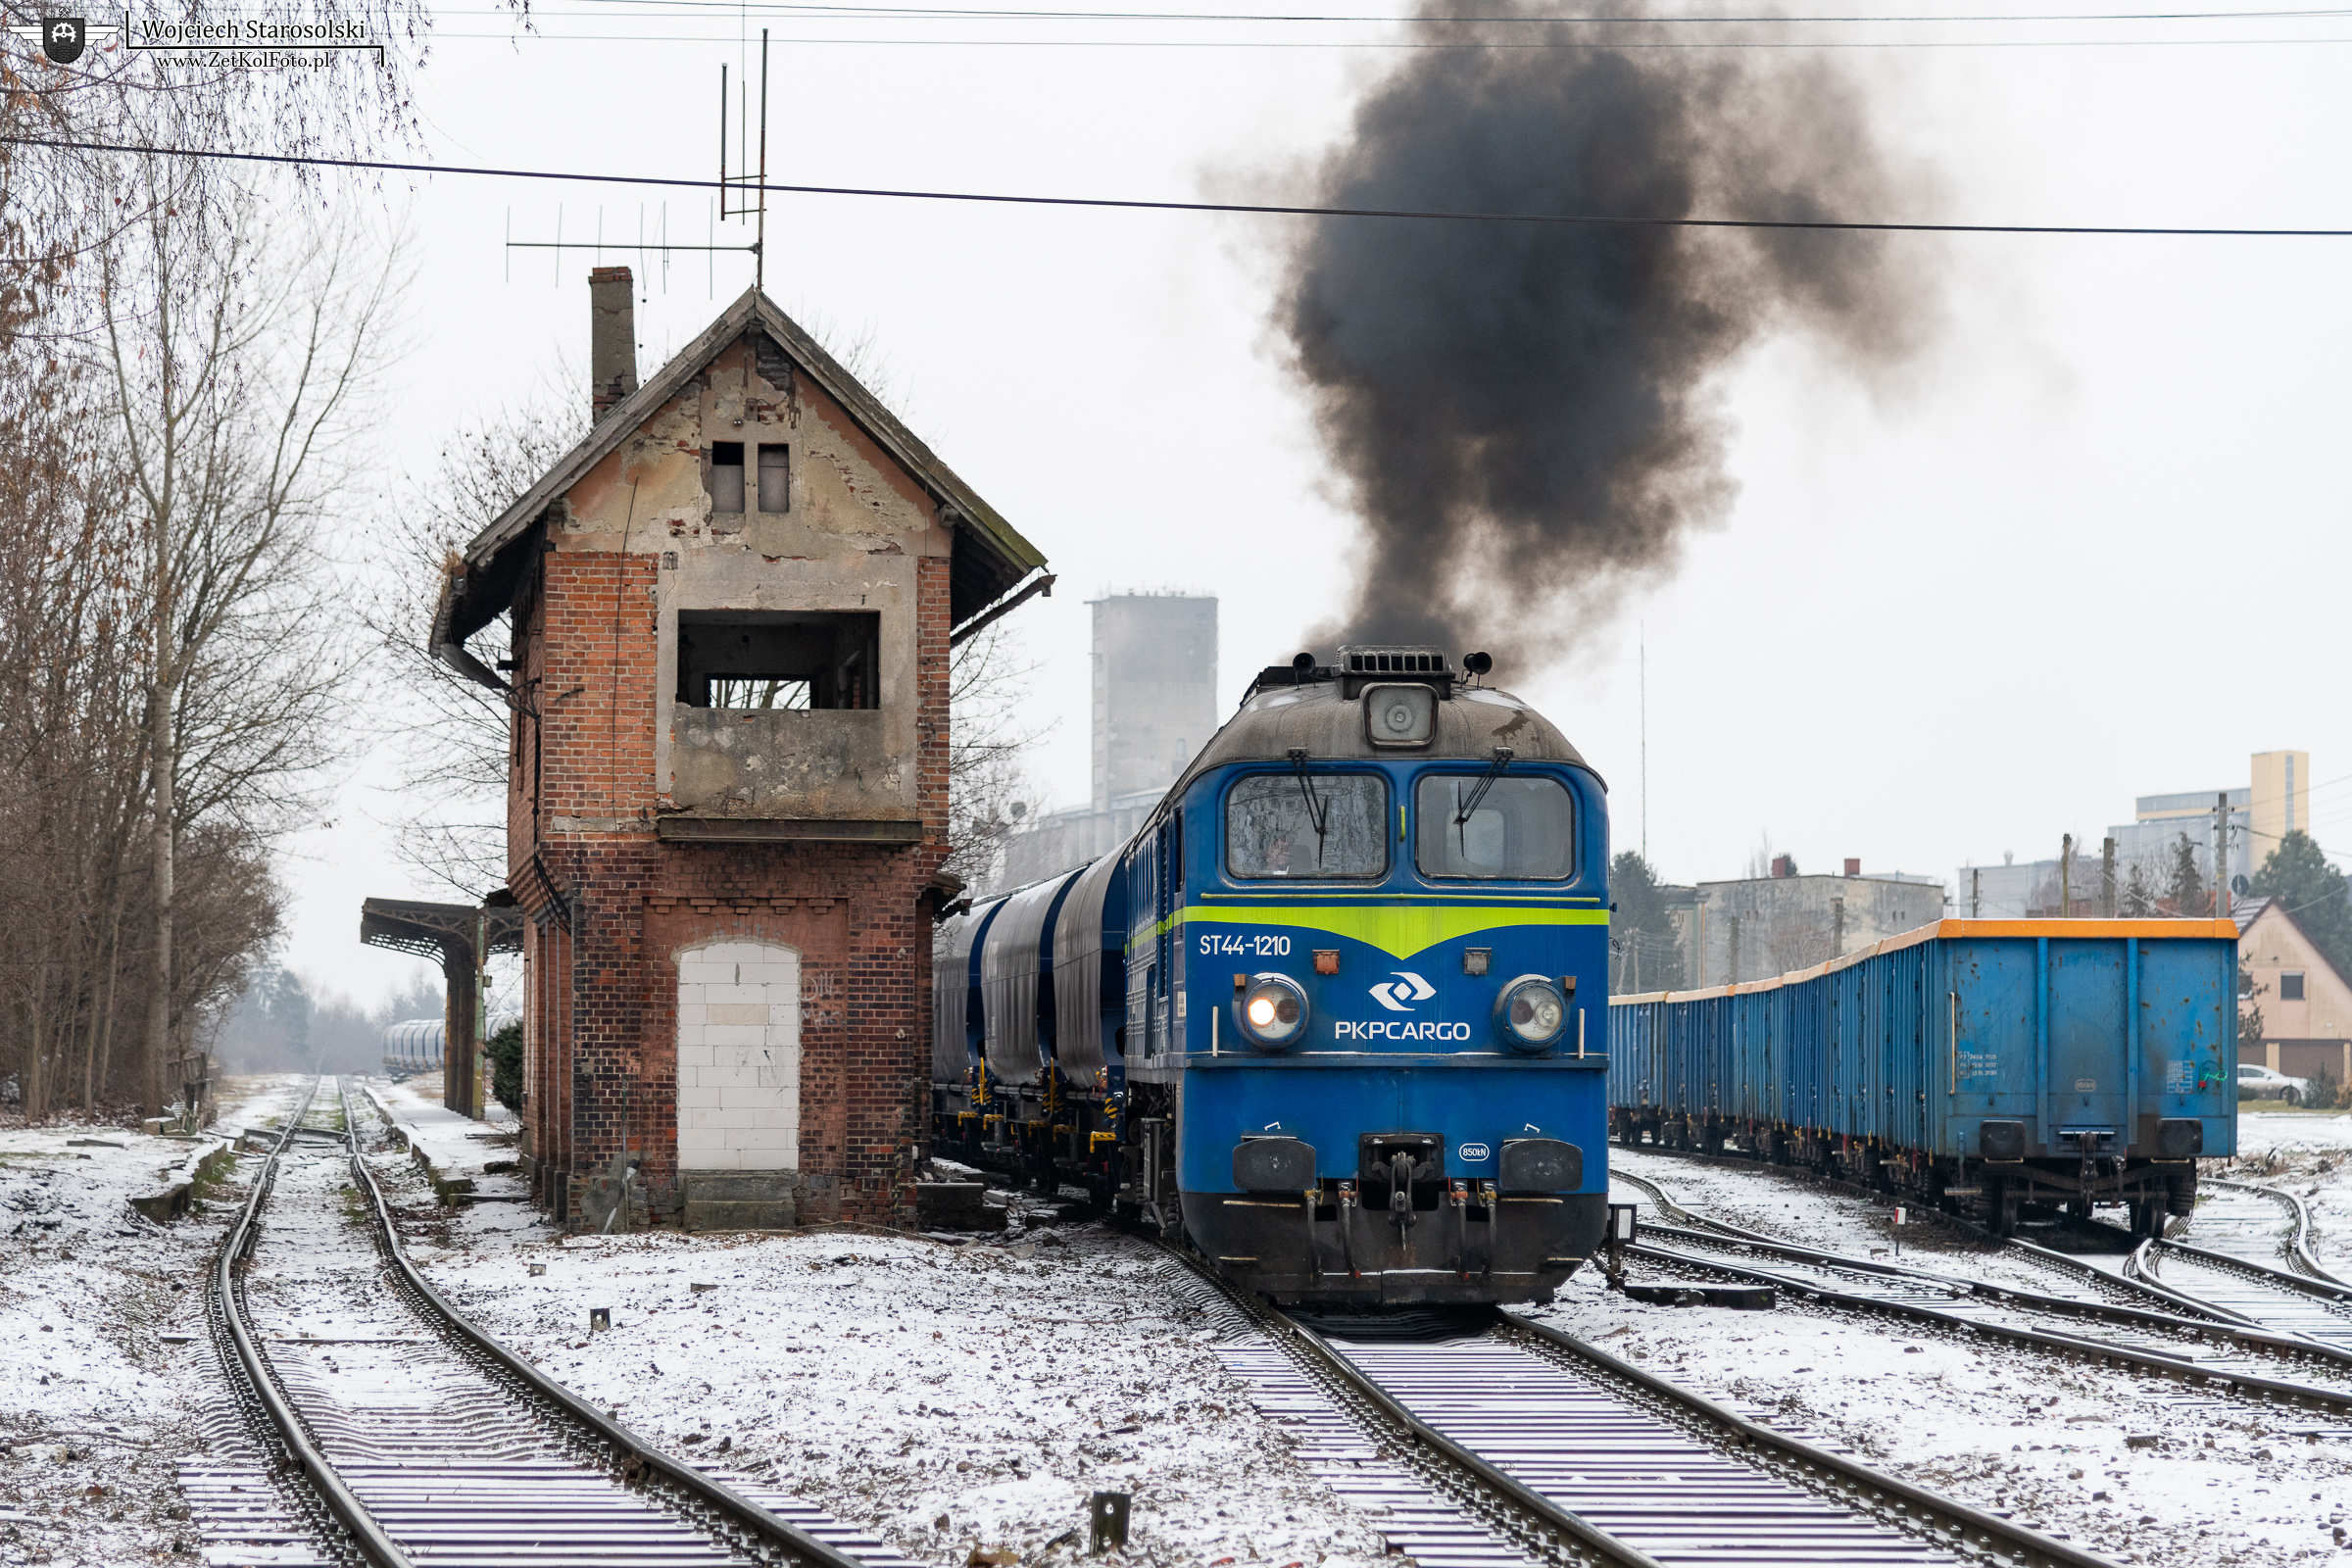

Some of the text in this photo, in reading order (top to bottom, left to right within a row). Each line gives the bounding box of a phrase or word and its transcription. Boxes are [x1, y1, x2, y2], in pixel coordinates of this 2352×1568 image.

[1200, 935, 1291, 956] ST44-1210
[1335, 1021, 1471, 1041] PKPCARGO
[1462, 1148, 1487, 1156] 850kN
